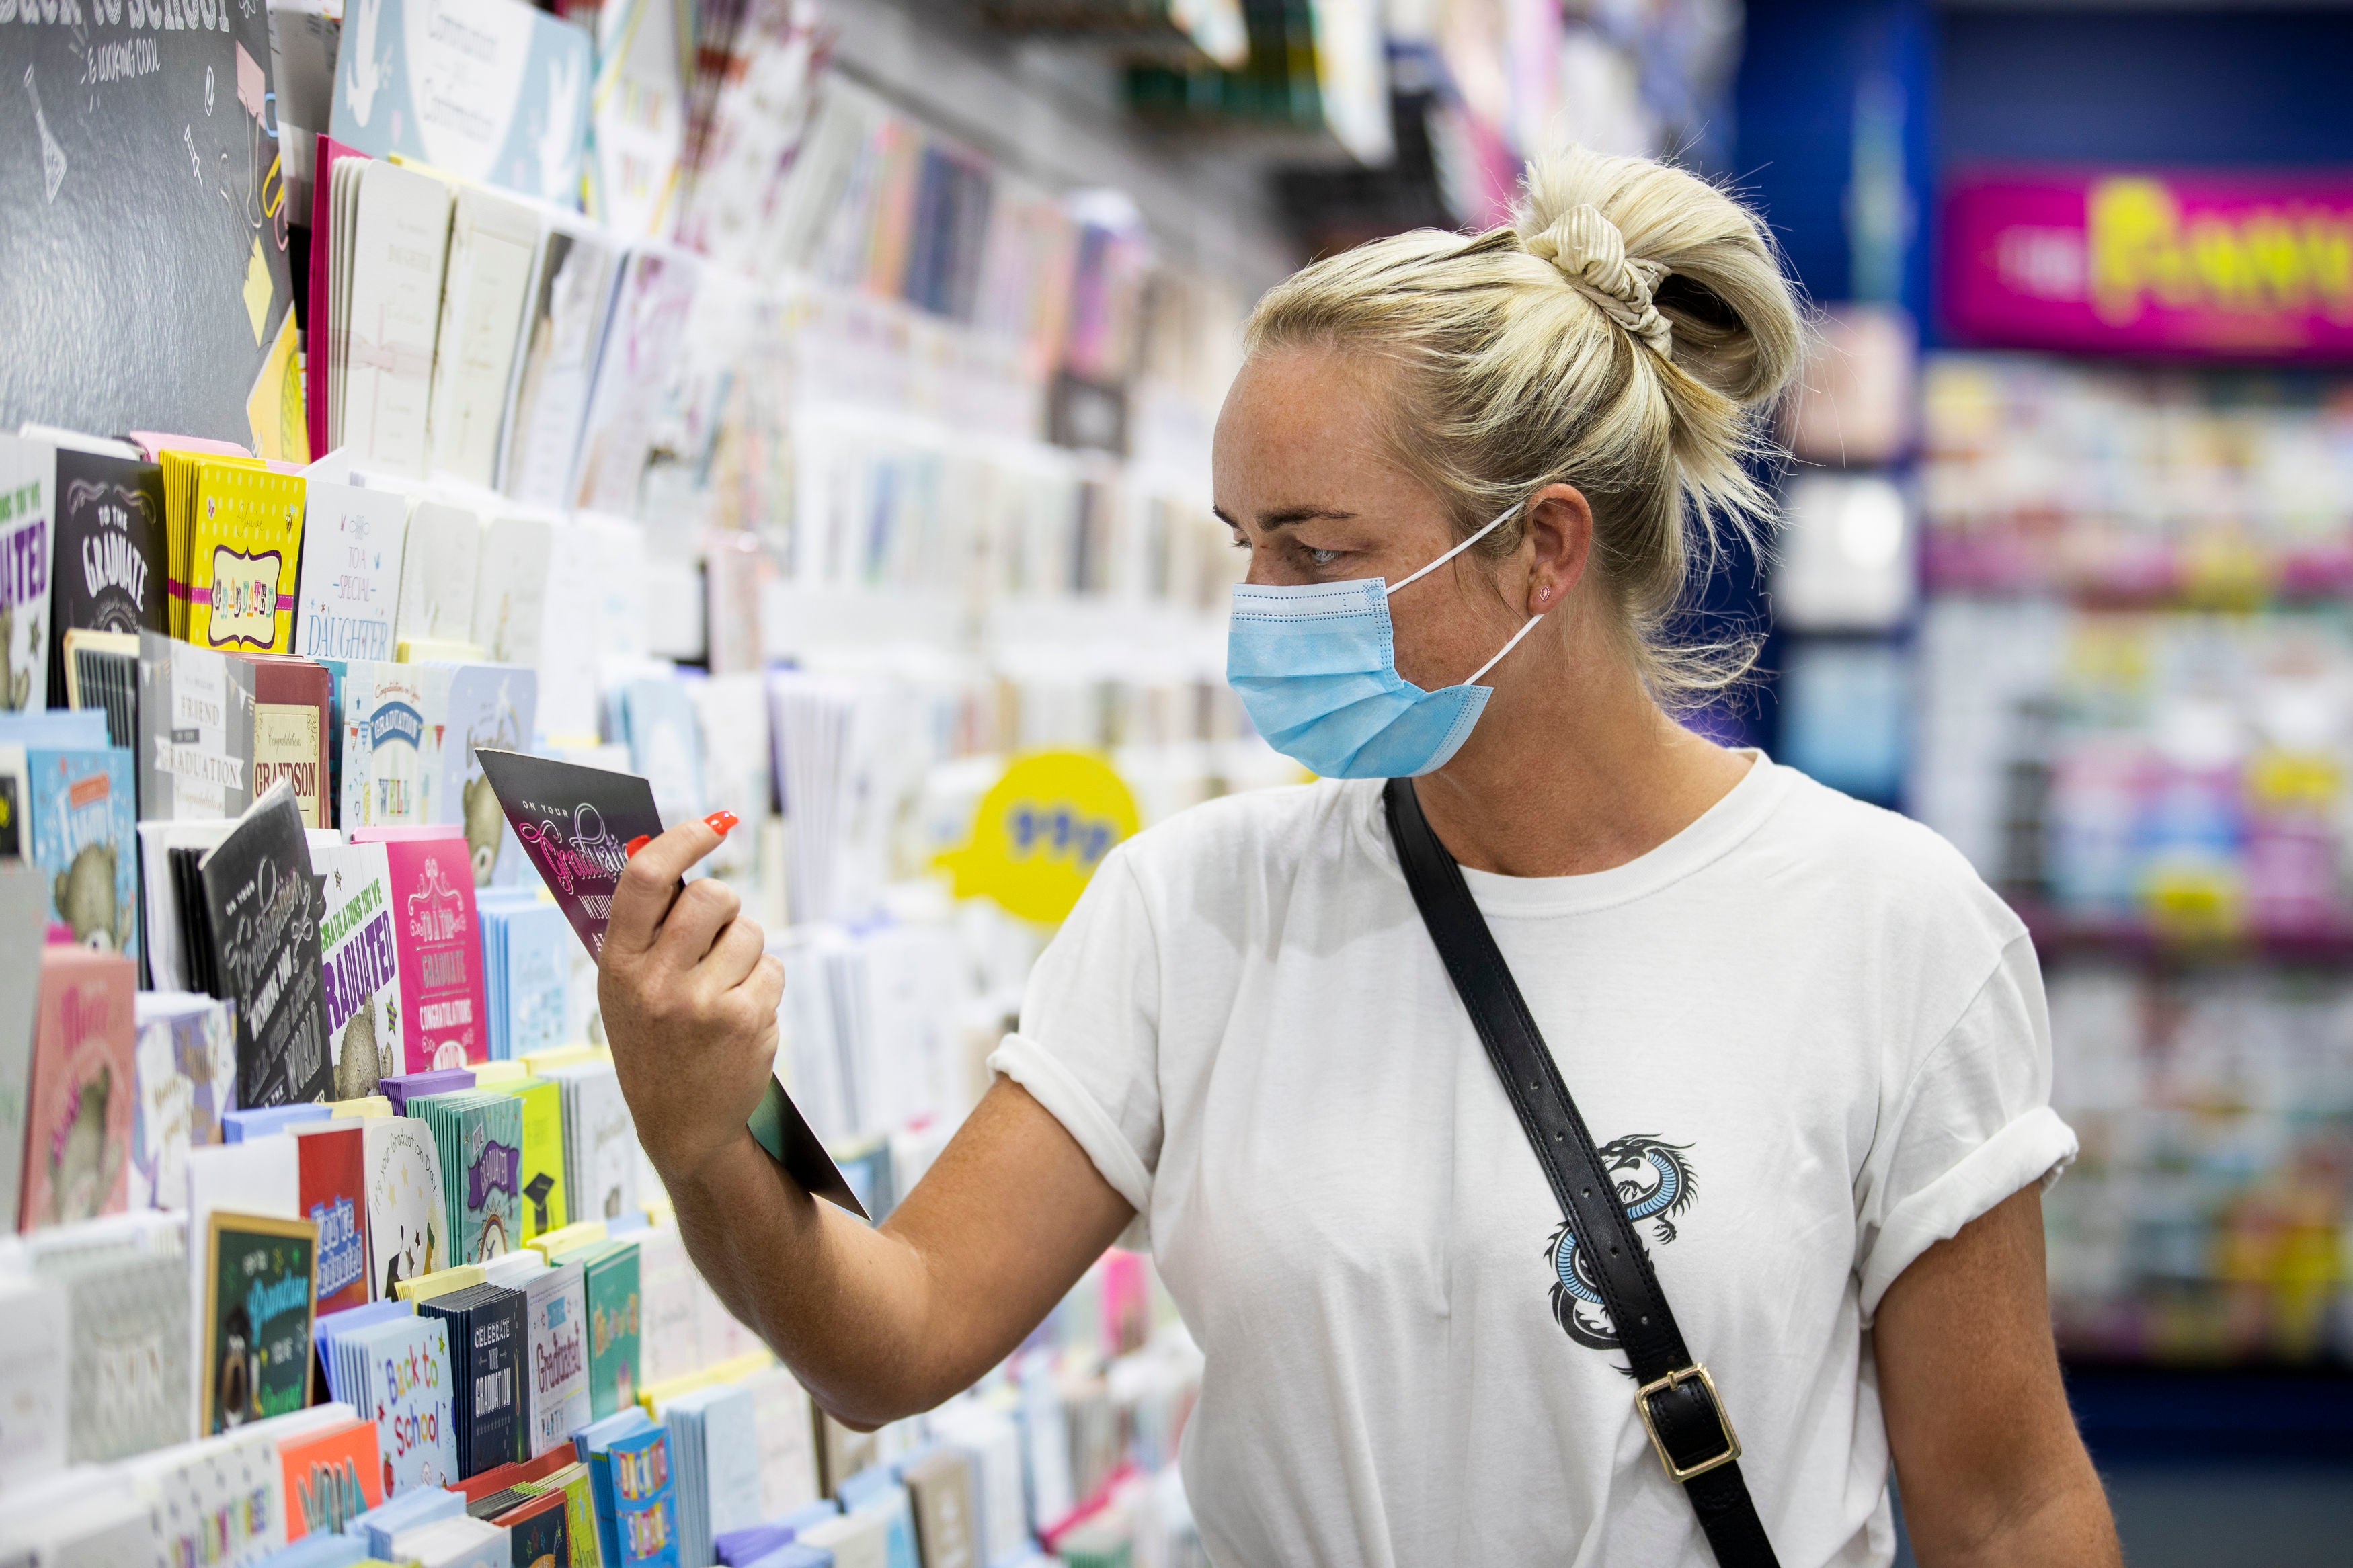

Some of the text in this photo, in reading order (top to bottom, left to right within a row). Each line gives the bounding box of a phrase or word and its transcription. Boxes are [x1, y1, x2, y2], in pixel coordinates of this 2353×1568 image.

[97, 37, 136, 83] LOOKING
[136, 37, 161, 76] COOL
[99, 505, 128, 532] TO THE
[82, 530, 148, 613] GRADUATE
[348, 546, 366, 569] TO A
[214, 576, 275, 620] GRADUATED
[338, 575, 370, 602] SPECIAL
[307, 614, 388, 661] DAUGHTER
[180, 694, 221, 727] FRIEND
[374, 709, 418, 739] GRADUATION
[268, 725, 303, 755] Congratulations
[159, 745, 238, 787] GRADUATION
[378, 778, 410, 815] WELL
[522, 800, 569, 818] ON YOUR
[518, 802, 628, 895] Graduatio
[237, 879, 255, 905] YOUR
[360, 877, 382, 917] YOU'VE
[577, 895, 614, 919] WISHIN
[420, 911, 434, 942] TO
[422, 949, 467, 989] GRADUATE
[249, 943, 292, 1042] WISHING YOU
[420, 998, 473, 1032] CONGRATULATIONS
[283, 1001, 323, 1100] WORLD
[380, 1147, 391, 1183] your
[390, 1128, 424, 1162] Graduation
[479, 1148, 508, 1197] GRADUATED
[474, 1317, 510, 1349] CELEBRATE
[385, 1341, 438, 1406] Back to
[536, 1319, 582, 1394] Graduated
[475, 1367, 511, 1418] GRADUATION
